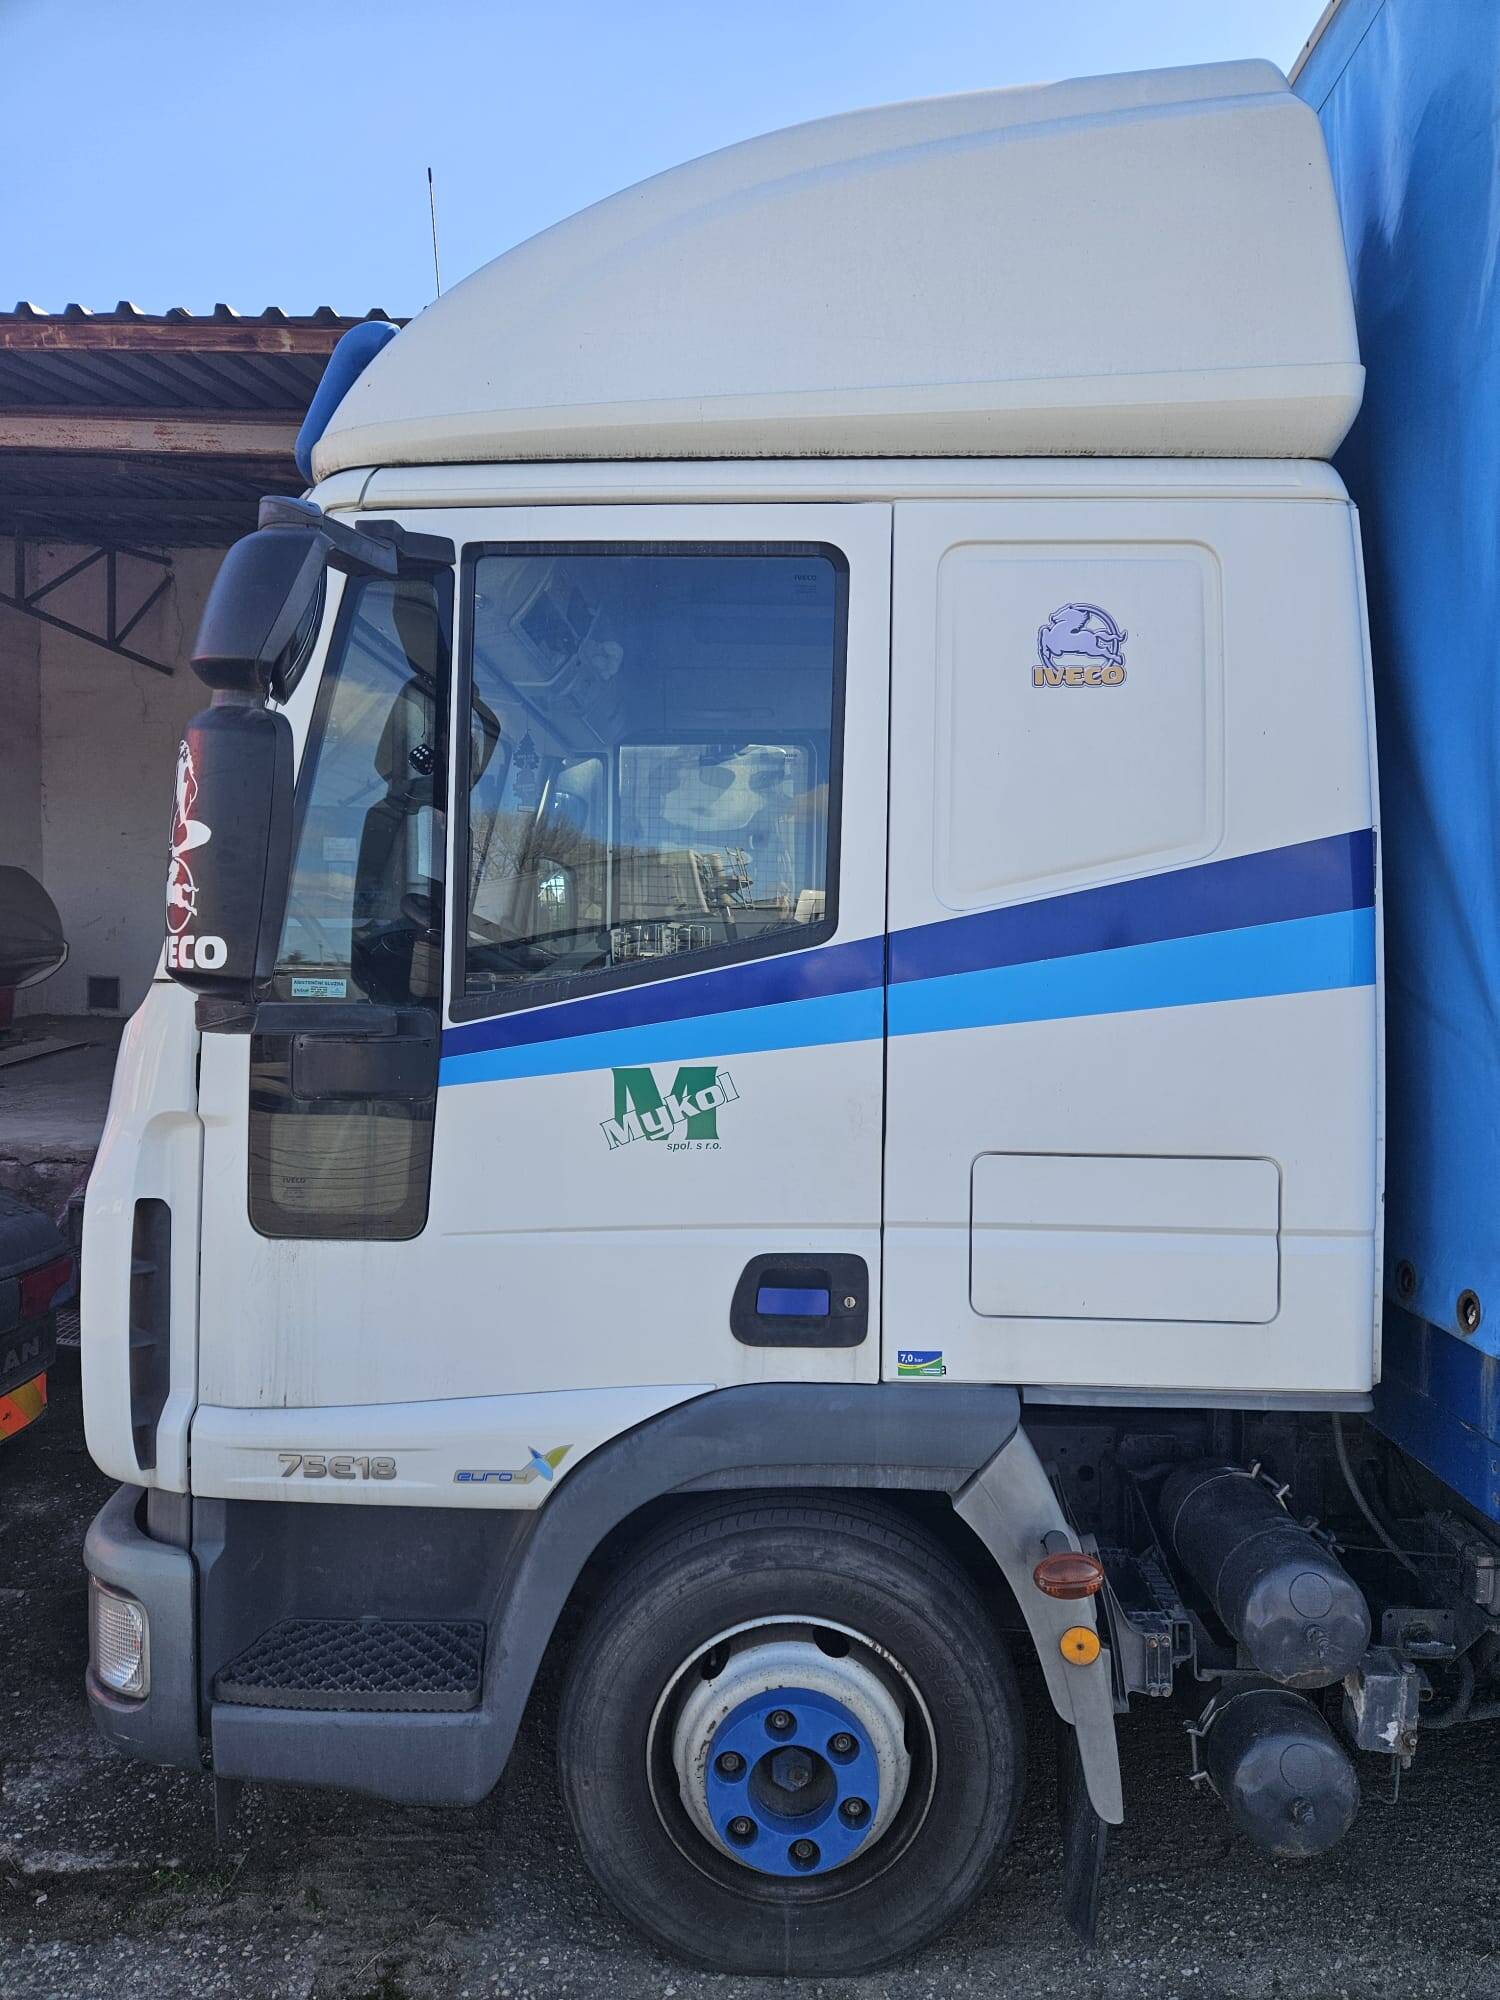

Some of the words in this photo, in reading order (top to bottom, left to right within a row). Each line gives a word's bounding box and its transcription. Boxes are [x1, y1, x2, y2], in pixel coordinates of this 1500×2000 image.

[1033, 666, 1127, 688] IVECO
[166, 934, 228, 970] ECO
[599, 1071, 740, 1151] Mykol
[666, 1141, 693, 1153] spol.
[705, 1142, 722, 1151] r.o.
[2, 1336, 40, 1374] AN
[900, 1353, 913, 1363] 7,0
[278, 1453, 399, 1481] 75E18
